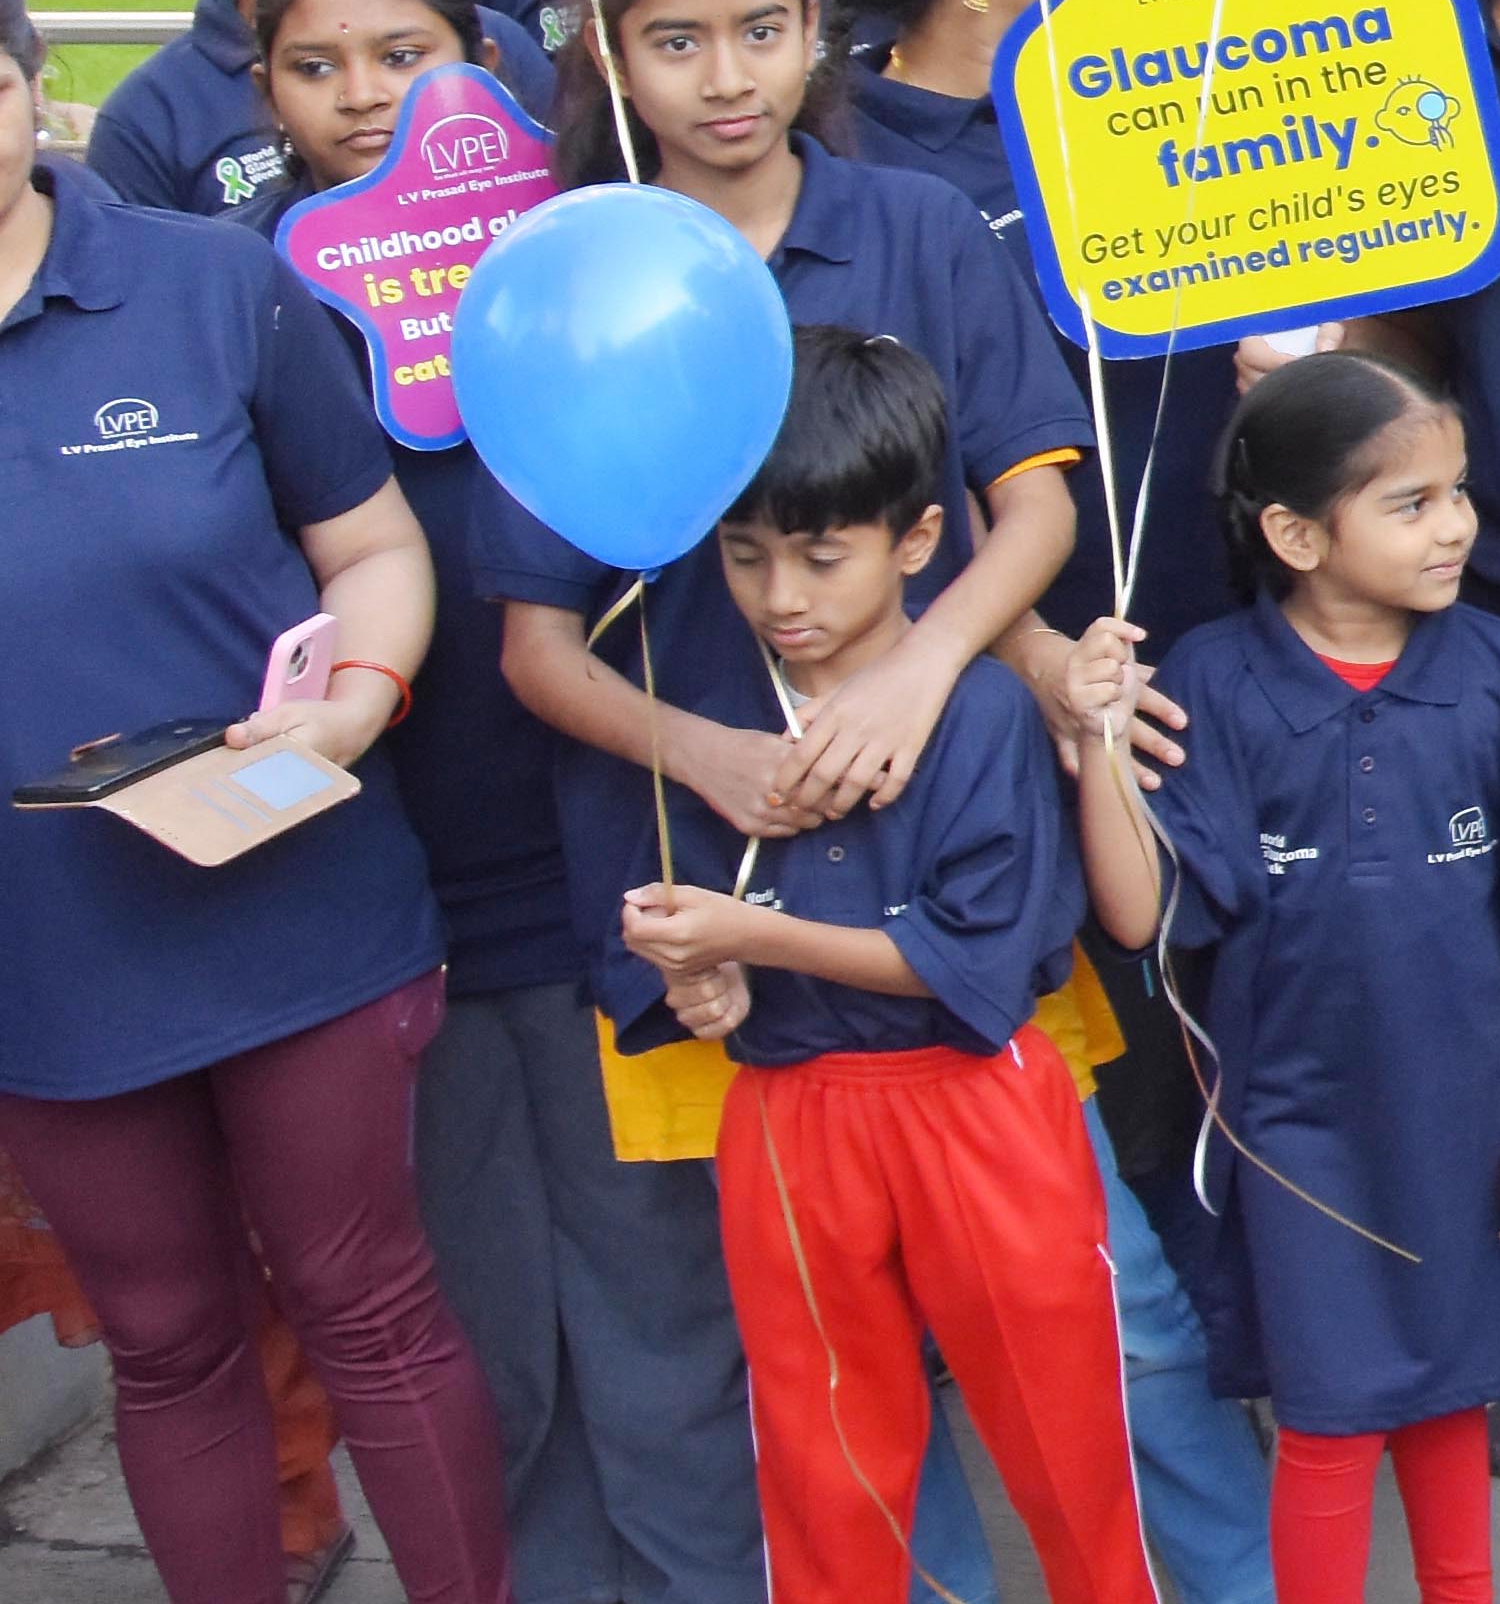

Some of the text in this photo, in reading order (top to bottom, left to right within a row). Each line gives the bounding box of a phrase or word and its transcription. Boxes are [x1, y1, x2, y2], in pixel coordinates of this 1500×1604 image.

[1067, 7, 1392, 99] Glaucoma
[1107, 100, 1185, 137] can
[1275, 73, 1311, 104] in
[1321, 61, 1388, 95] the
[426, 131, 508, 174] LVPEI
[1156, 115, 1380, 188] family.
[397, 167, 549, 205] L V Prasad Eye Institute
[1081, 169, 1461, 264] Get your child's eyes
[316, 216, 484, 271] Childhood
[1101, 210, 1481, 301] examined regularly.
[363, 273, 404, 308] is
[400, 311, 453, 341] But
[394, 354, 451, 386] cat
[99, 407, 157, 435] LVPEI
